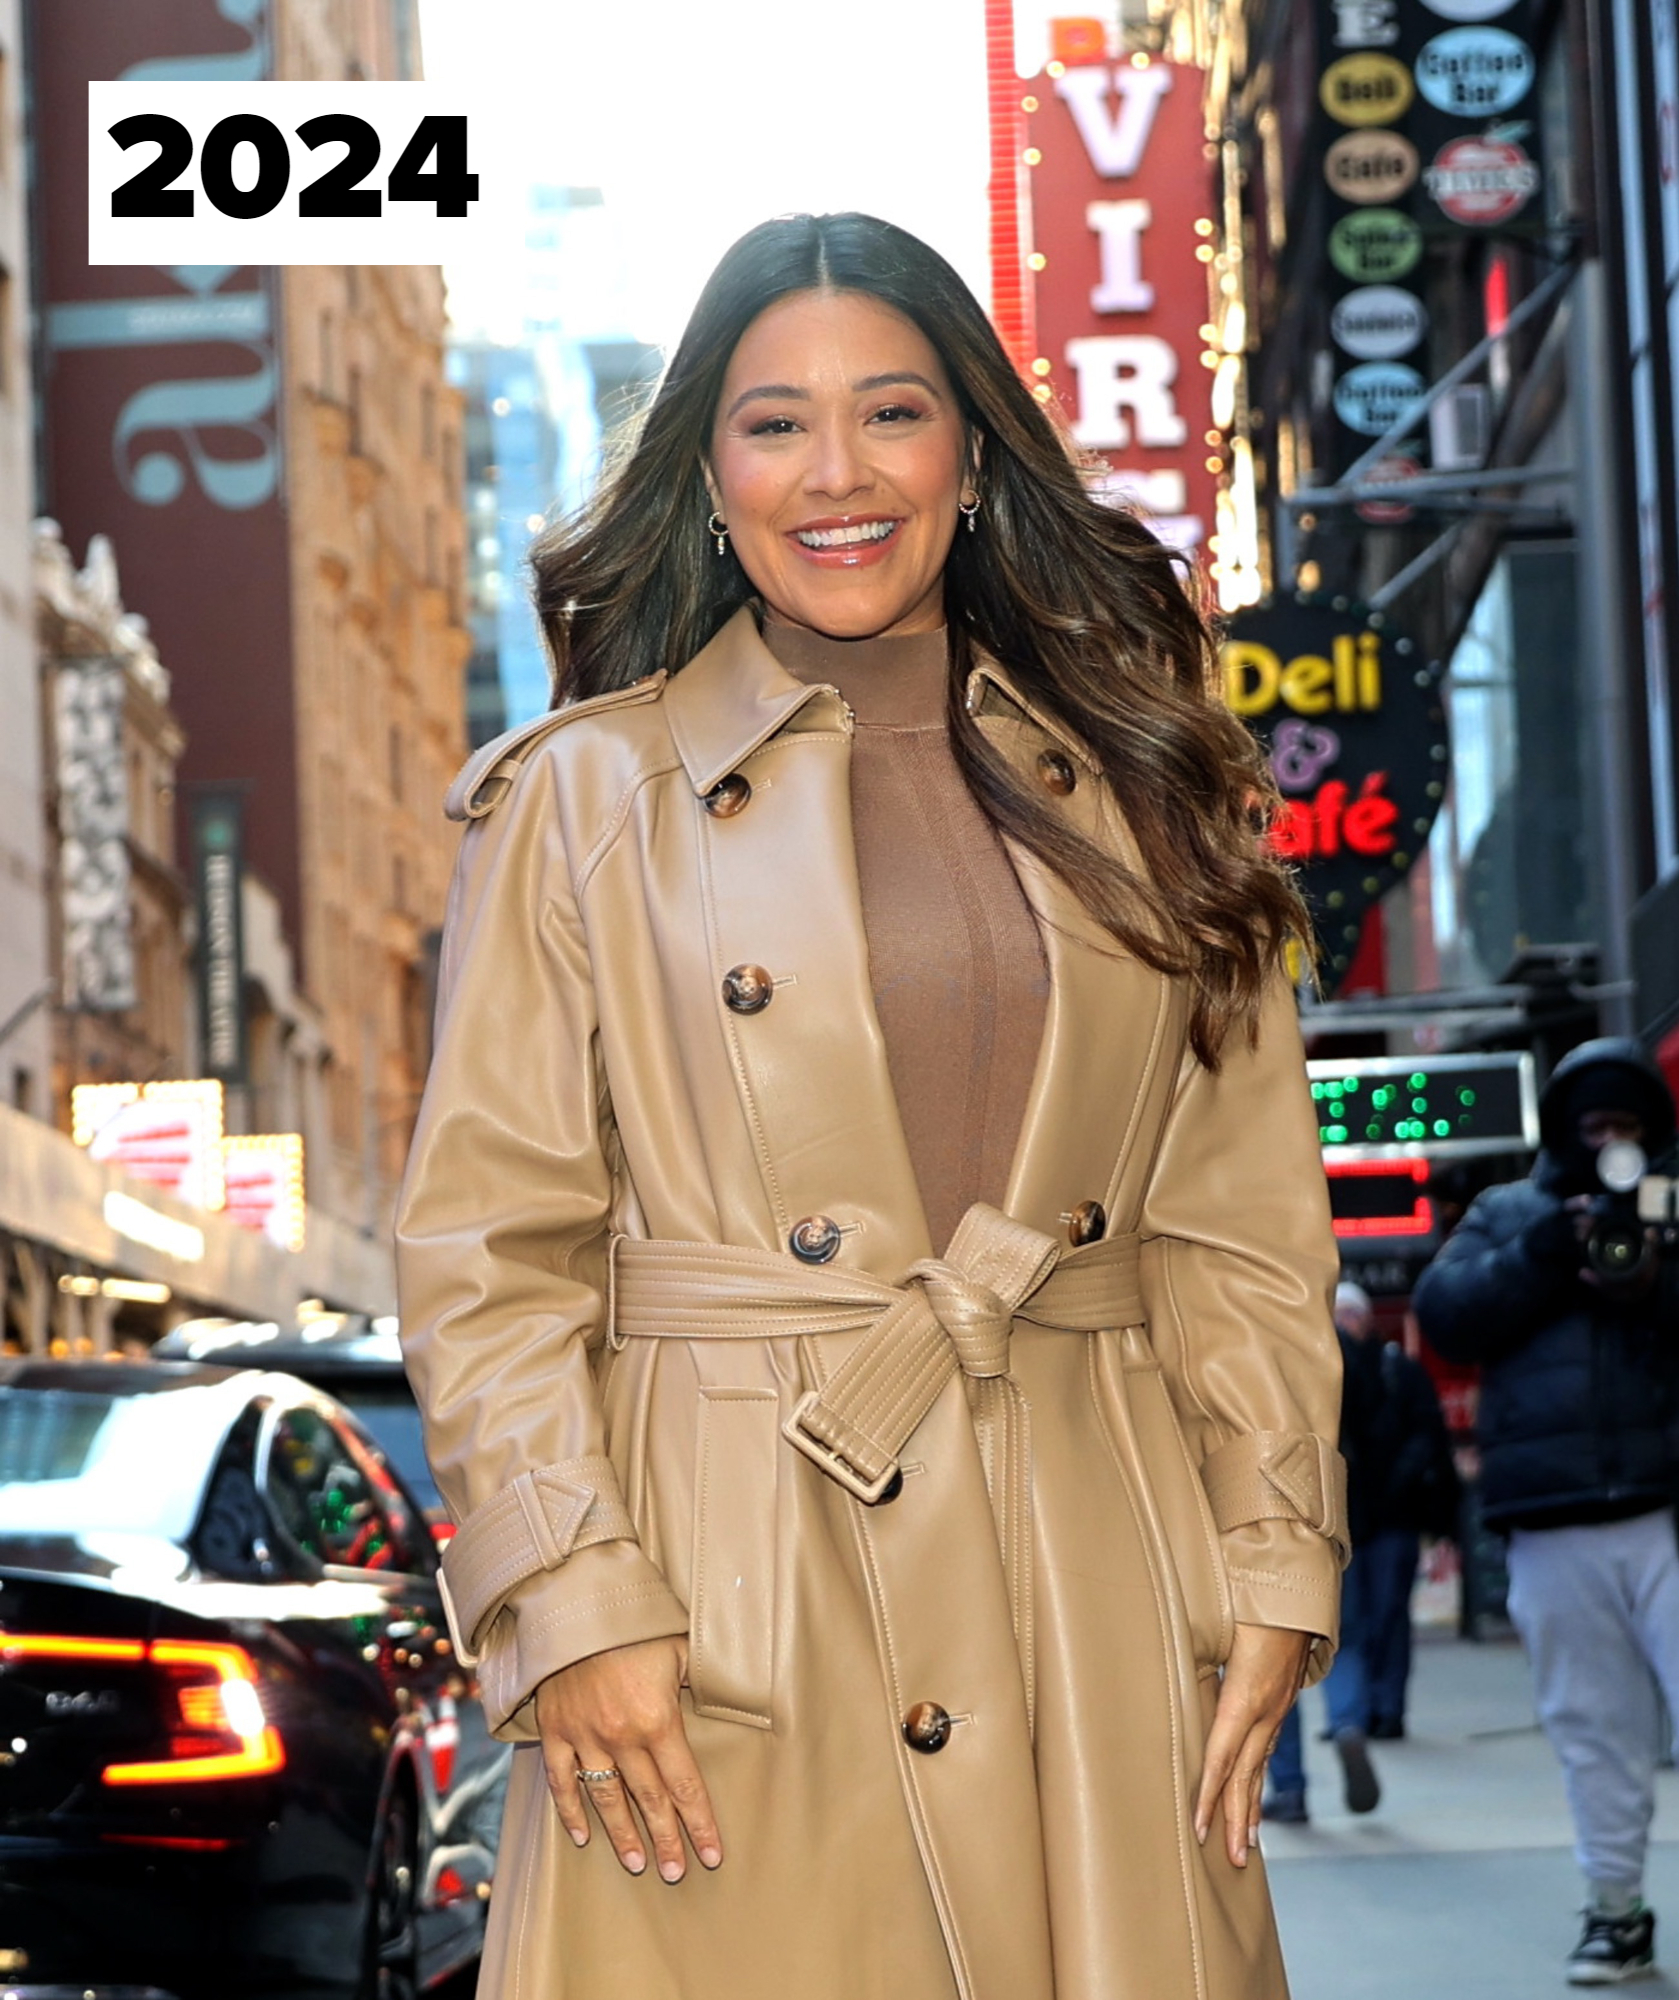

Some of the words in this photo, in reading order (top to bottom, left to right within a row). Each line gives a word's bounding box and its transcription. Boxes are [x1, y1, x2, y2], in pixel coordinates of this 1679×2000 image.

[1222, 632, 1381, 716] Deli
[1272, 717, 1341, 793] &
[1246, 771, 1399, 858] afé
